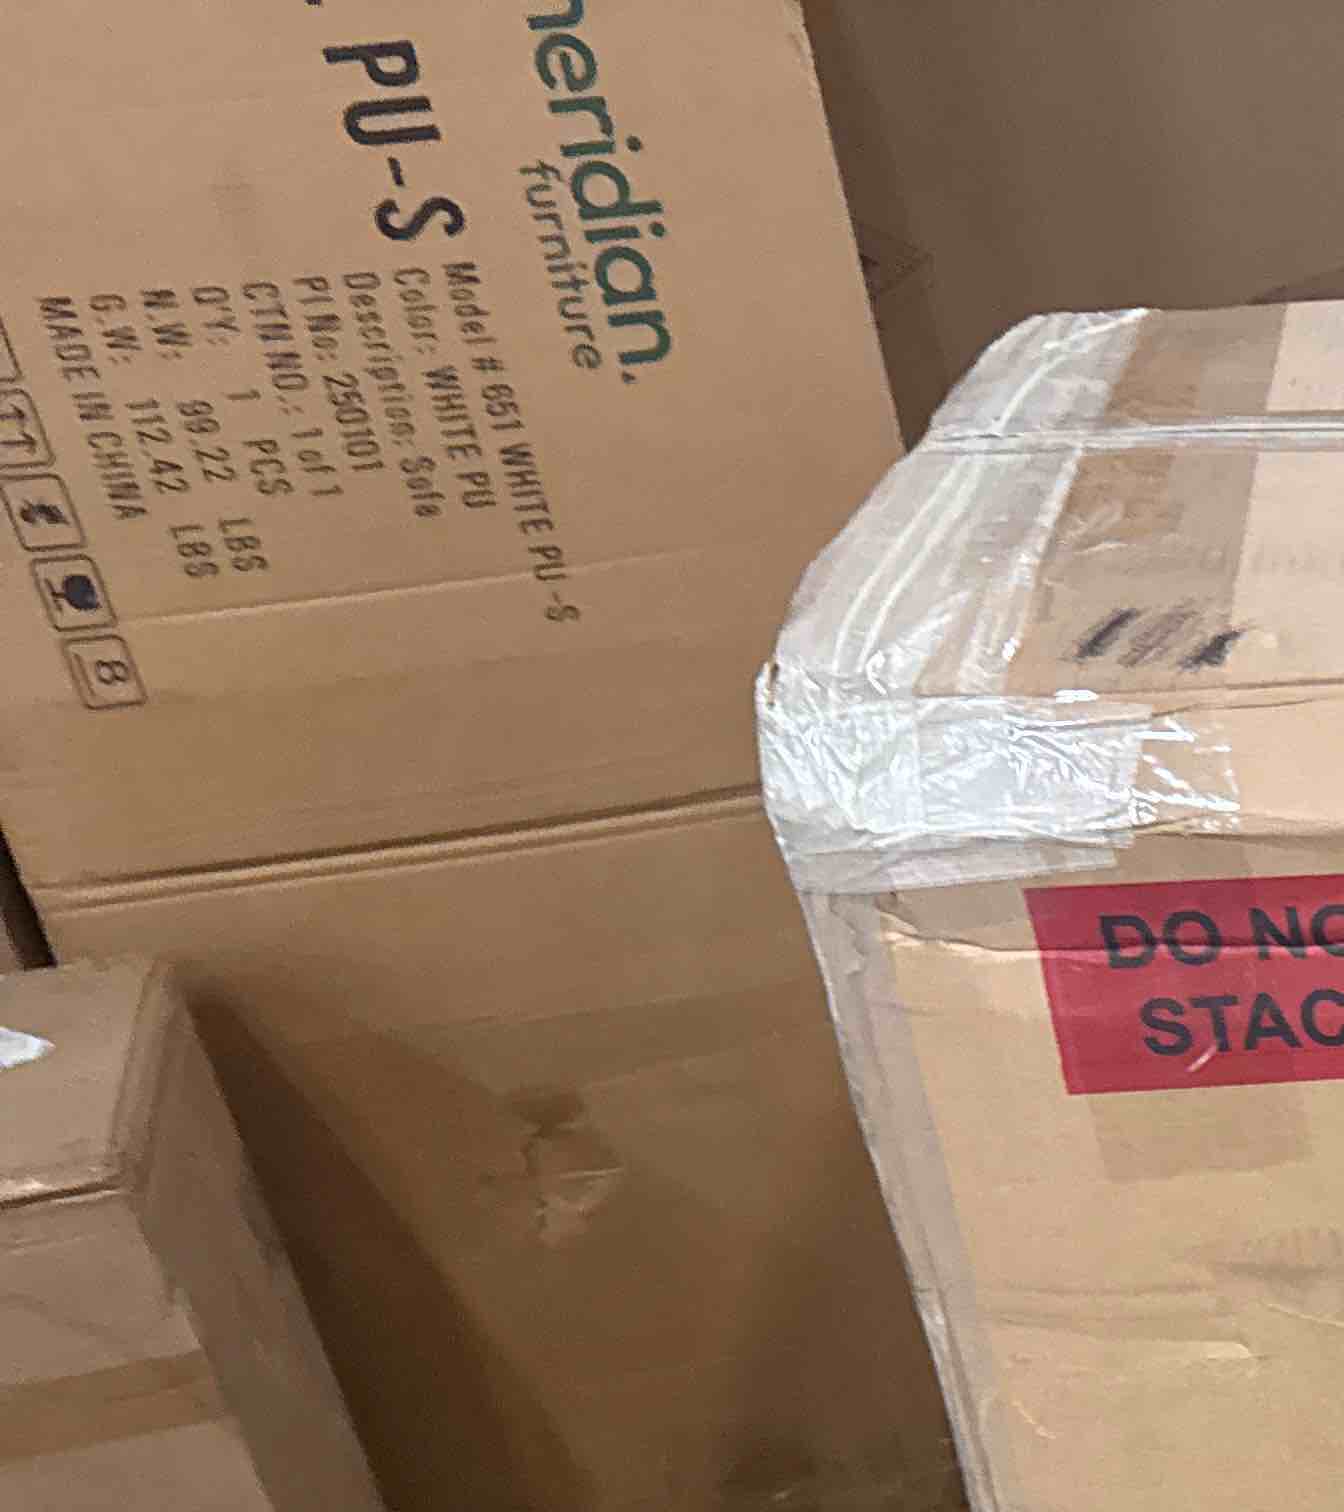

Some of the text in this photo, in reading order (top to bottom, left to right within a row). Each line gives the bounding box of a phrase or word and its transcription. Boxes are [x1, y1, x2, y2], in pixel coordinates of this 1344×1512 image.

[322, 39, 466, 242] PU-S
[242, 280, 295, 342] CTN
[517, 160, 603, 371] furniture
[34, 296, 149, 521] MADE IN CHINA
[321, 371, 385, 472] 250101
[342, 272, 416, 448] Description:
[393, 267, 498, 509] Color: WHITE PU
[441, 262, 498, 345] Model
[499, 442, 555, 535] WHITE
[527, 545, 568, 581] PU
[242, 438, 295, 497] PCS
[167, 523, 220, 579] LBS
[218, 516, 270, 573] LBS
[1097, 908, 1223, 969] DO
